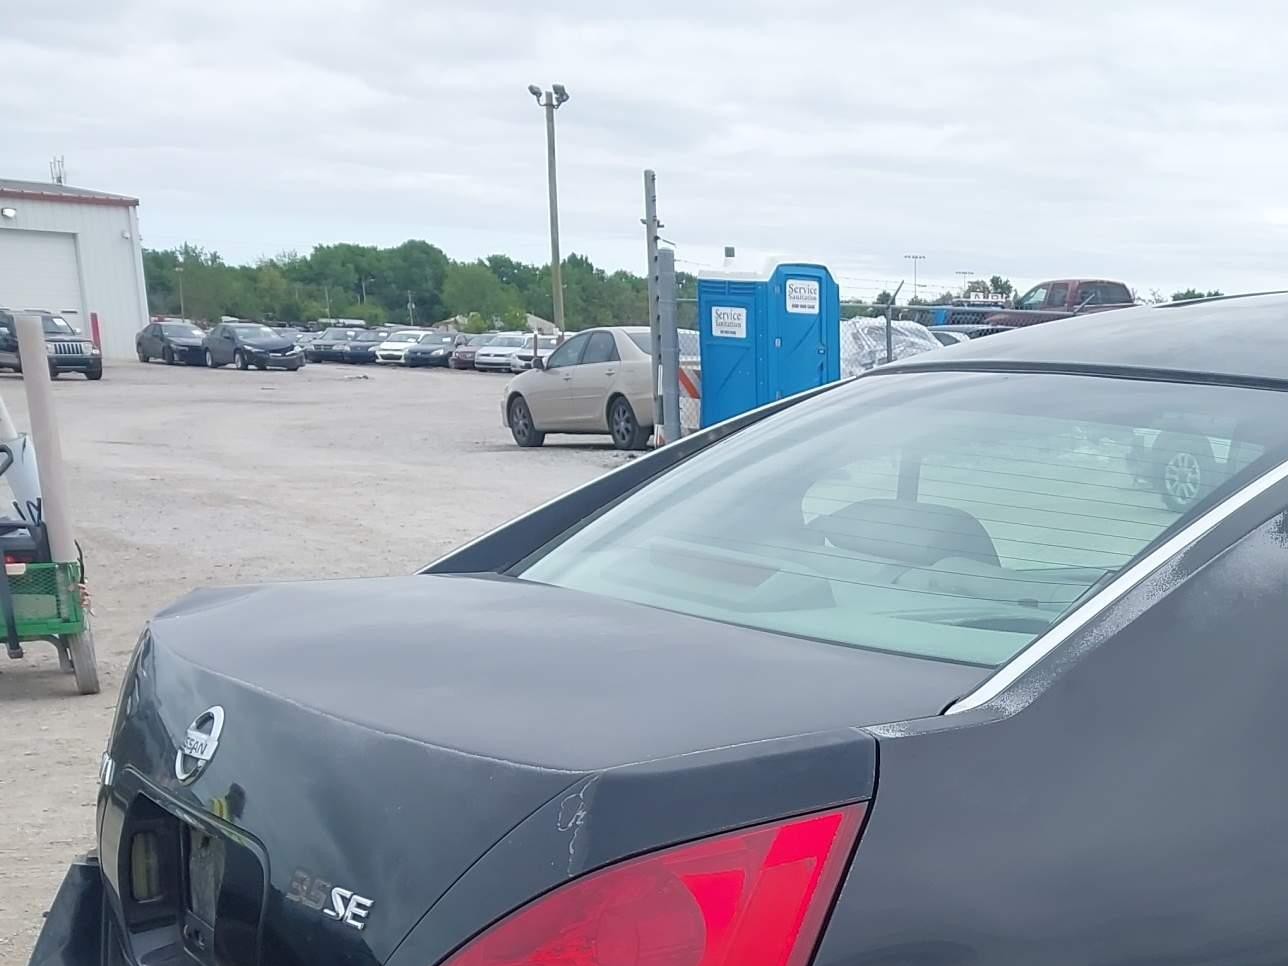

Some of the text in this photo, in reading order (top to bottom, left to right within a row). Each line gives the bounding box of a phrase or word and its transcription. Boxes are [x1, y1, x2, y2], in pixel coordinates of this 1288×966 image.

[788, 283, 817, 295] Service
[715, 308, 742, 321] Service
[322, 886, 375, 931] SE
